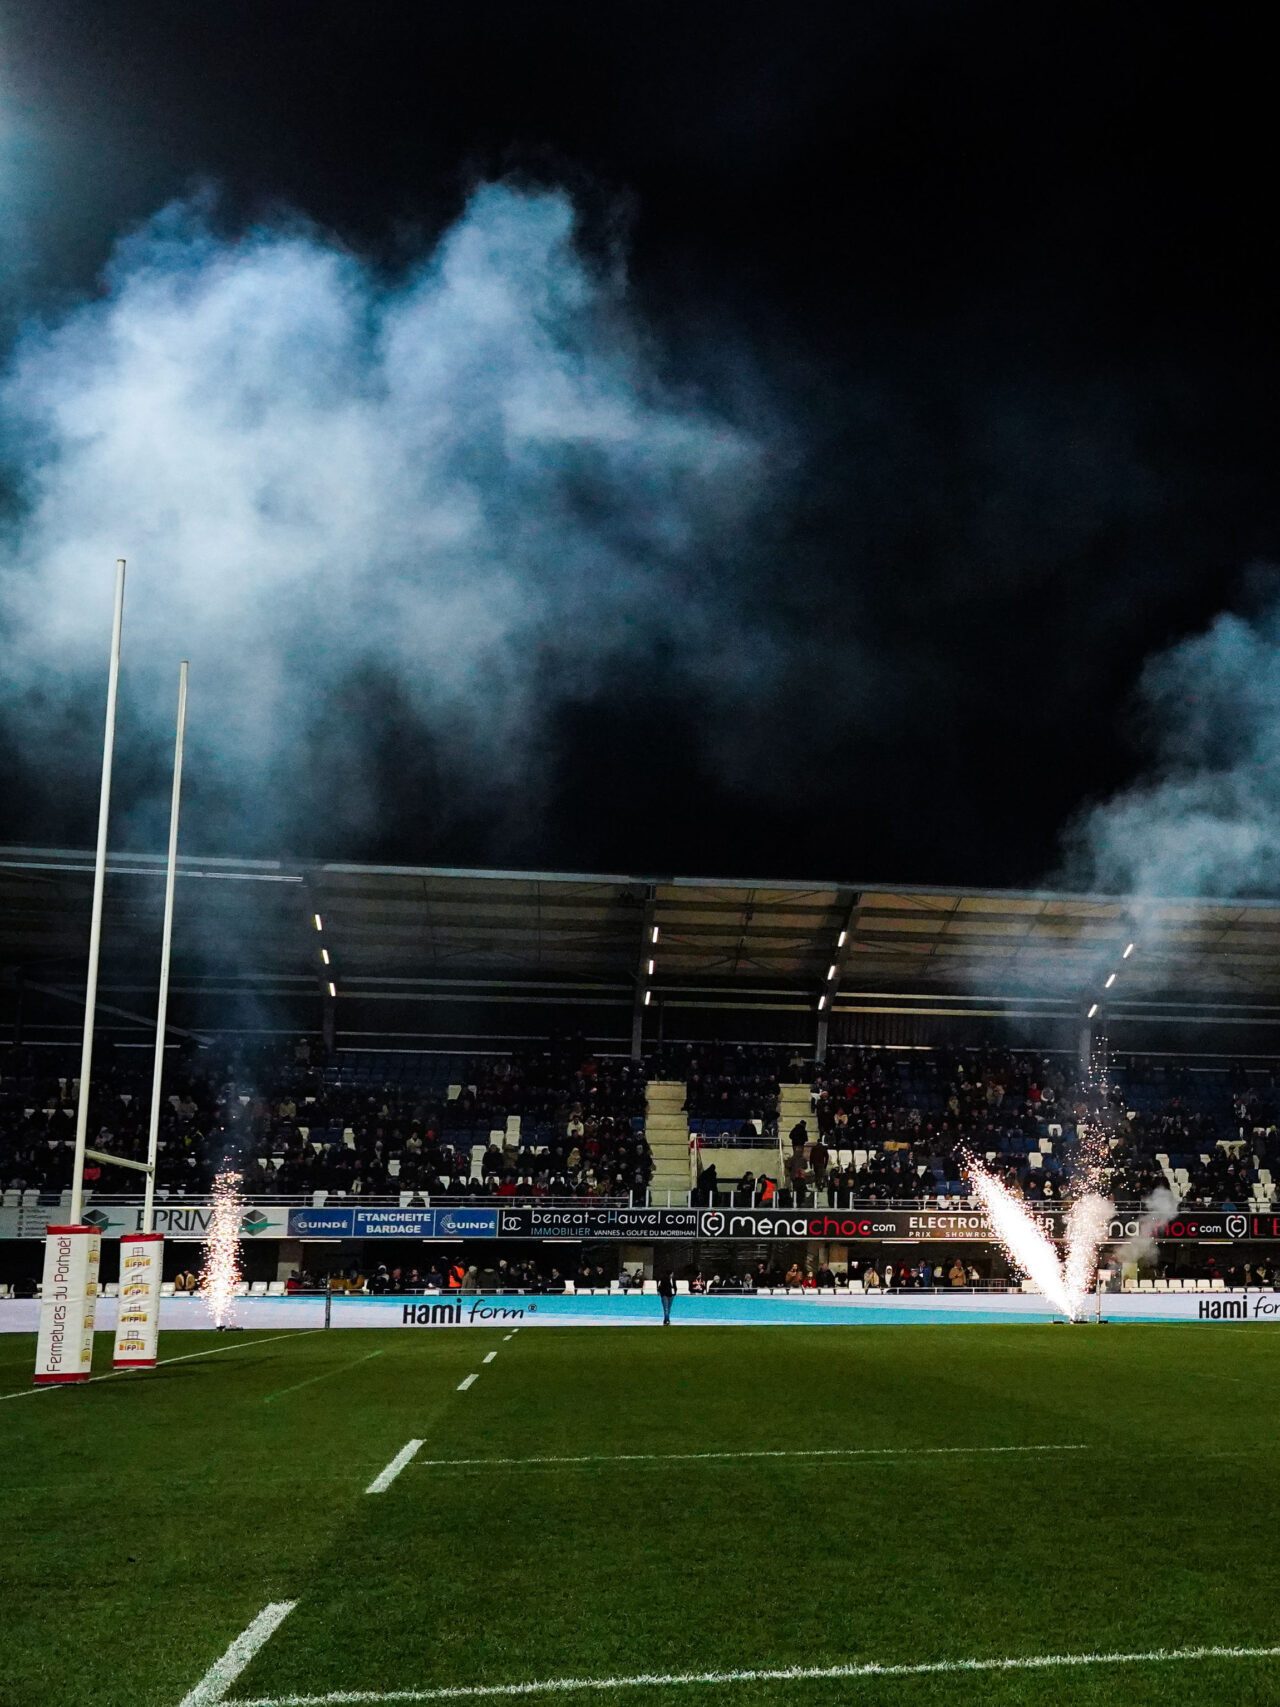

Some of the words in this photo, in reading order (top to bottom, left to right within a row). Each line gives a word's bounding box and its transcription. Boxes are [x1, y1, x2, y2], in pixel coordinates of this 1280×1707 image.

[357, 1212, 431, 1222] ETANCHEITE
[298, 1217, 348, 1230] GUINDÉ
[447, 1220, 495, 1230] GUINDÉ
[366, 1225, 421, 1234] BARDAGE
[531, 1227, 590, 1236] IMMOBILIER
[52, 1285, 68, 1301] du
[402, 1298, 462, 1324] Hami
[467, 1299, 524, 1324] form
[1198, 1294, 1248, 1319] Hami
